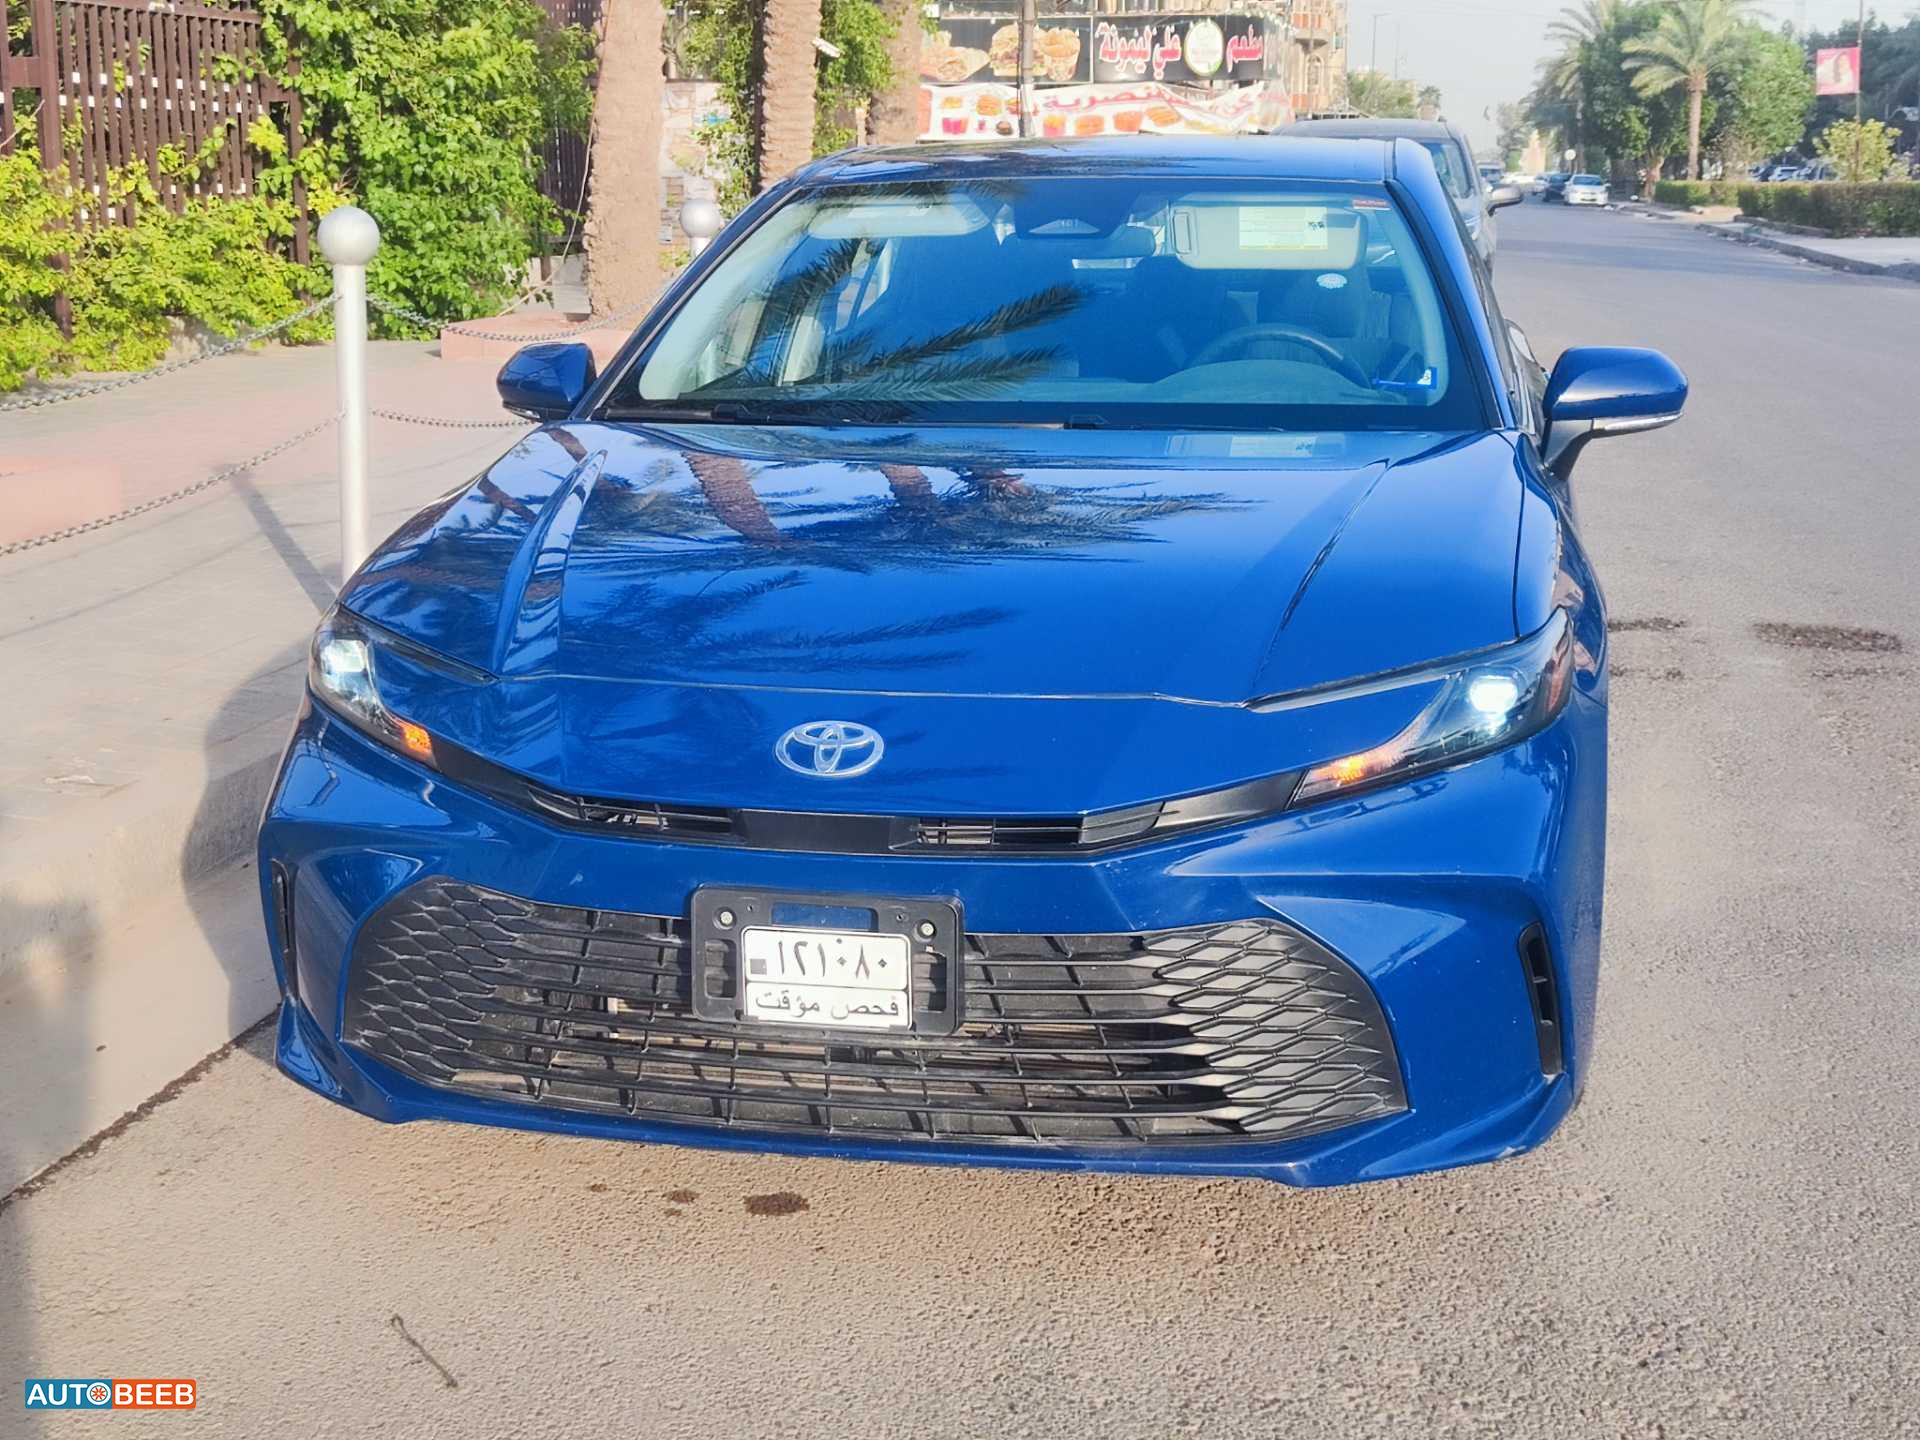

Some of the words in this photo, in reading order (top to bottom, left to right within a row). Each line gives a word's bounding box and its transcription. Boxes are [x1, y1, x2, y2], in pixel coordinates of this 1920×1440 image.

[778, 938, 888, 980] ١٢١٠٨٠
[755, 989, 820, 1018] مؤقت
[830, 994, 900, 1021] فحص
